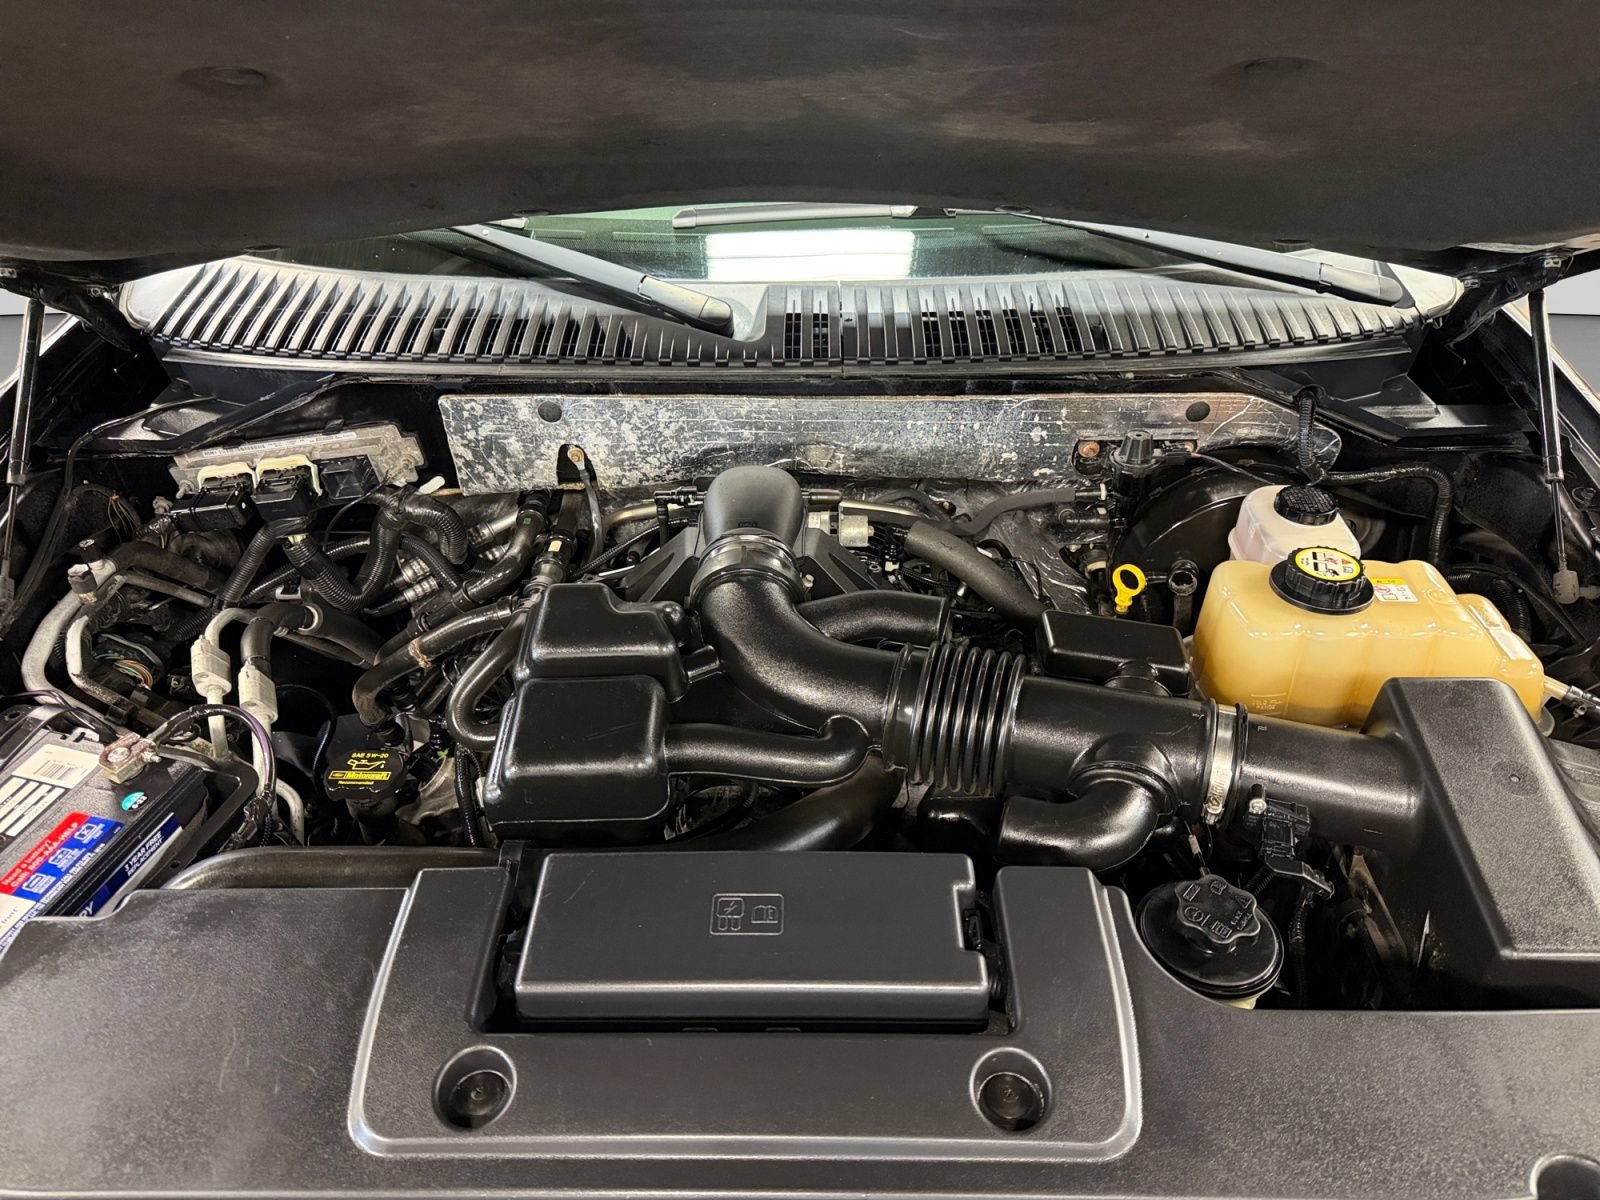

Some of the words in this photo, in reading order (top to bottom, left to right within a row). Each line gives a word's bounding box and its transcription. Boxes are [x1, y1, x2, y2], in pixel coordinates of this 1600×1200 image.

[124, 864, 130, 872] 3
[129, 847, 146, 866] YEAR
[145, 830, 162, 850] FREE
